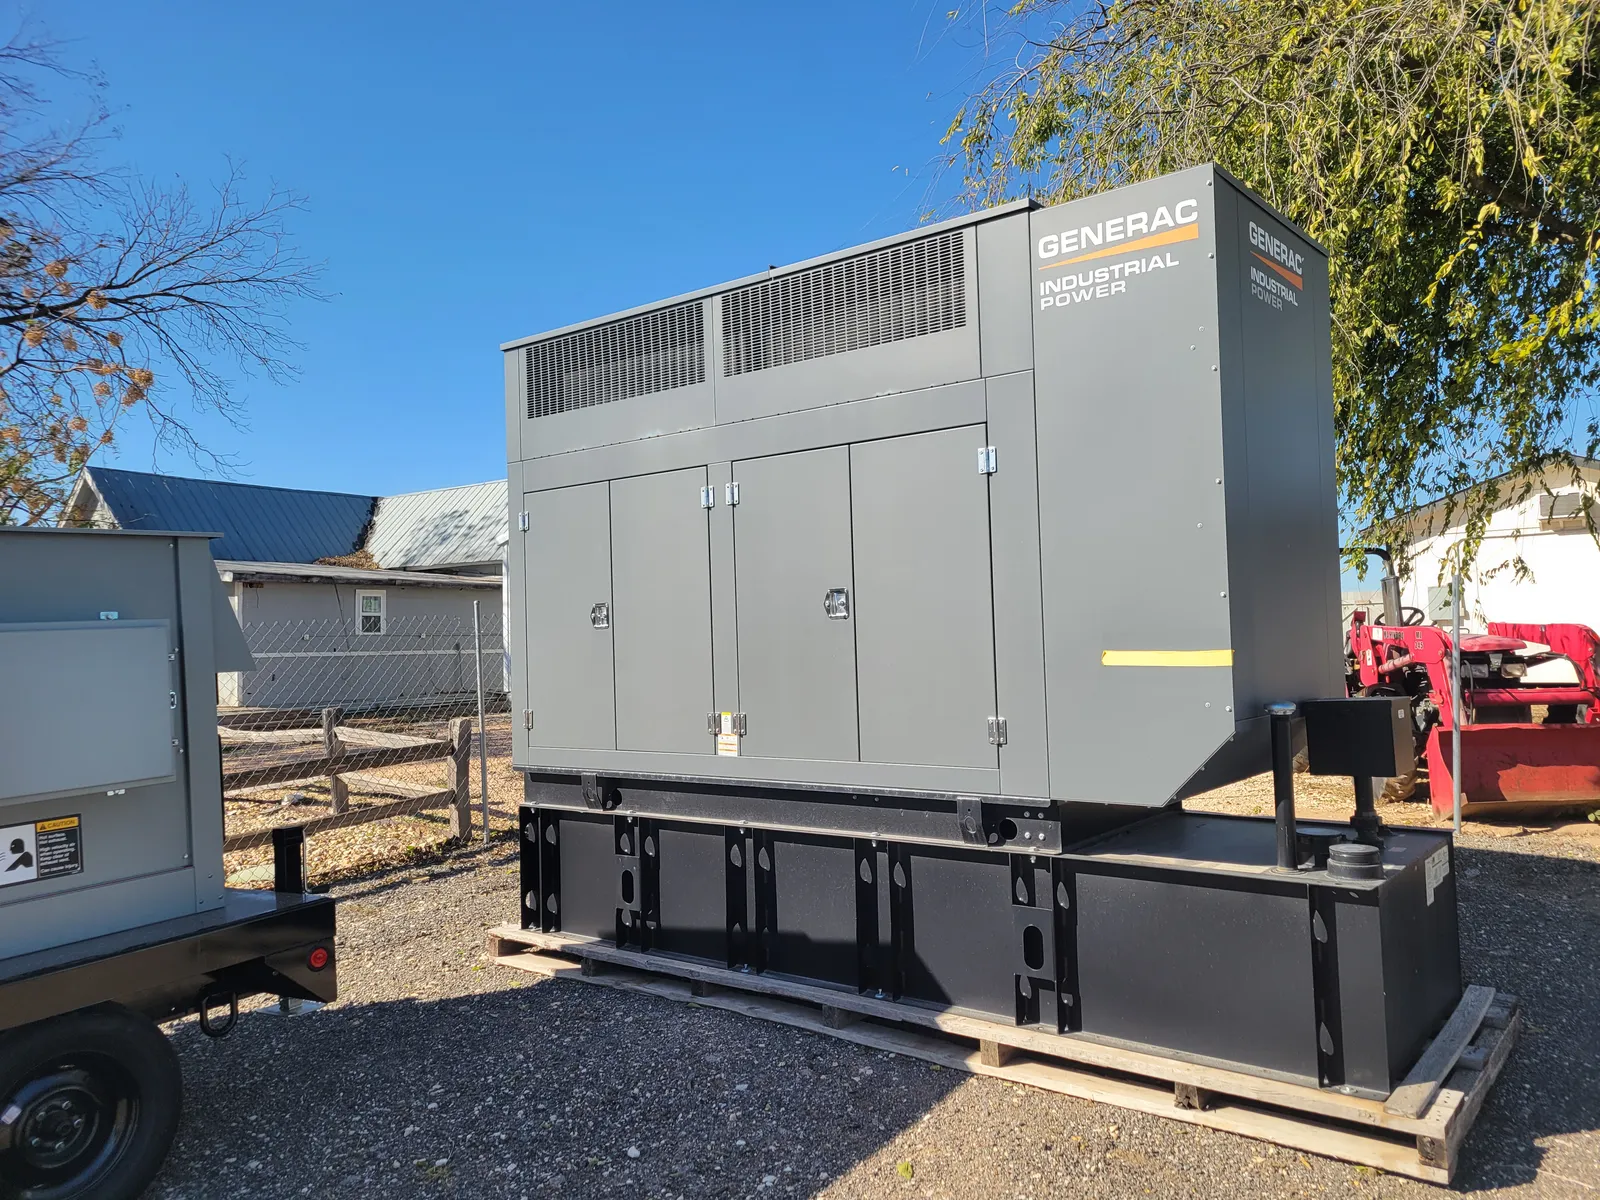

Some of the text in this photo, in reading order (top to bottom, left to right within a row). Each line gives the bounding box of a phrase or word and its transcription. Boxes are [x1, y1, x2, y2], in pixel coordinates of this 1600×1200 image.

[1038, 198, 1198, 259] GENERAC
[1249, 221, 1303, 275] GENERAC
[1040, 252, 1179, 296] INDUSTRIAL
[1250, 265, 1298, 306] INDUSTRIAL
[1040, 280, 1126, 311] POWER
[1251, 282, 1283, 311] POWER
[48, 820, 76, 828] CAUTION
